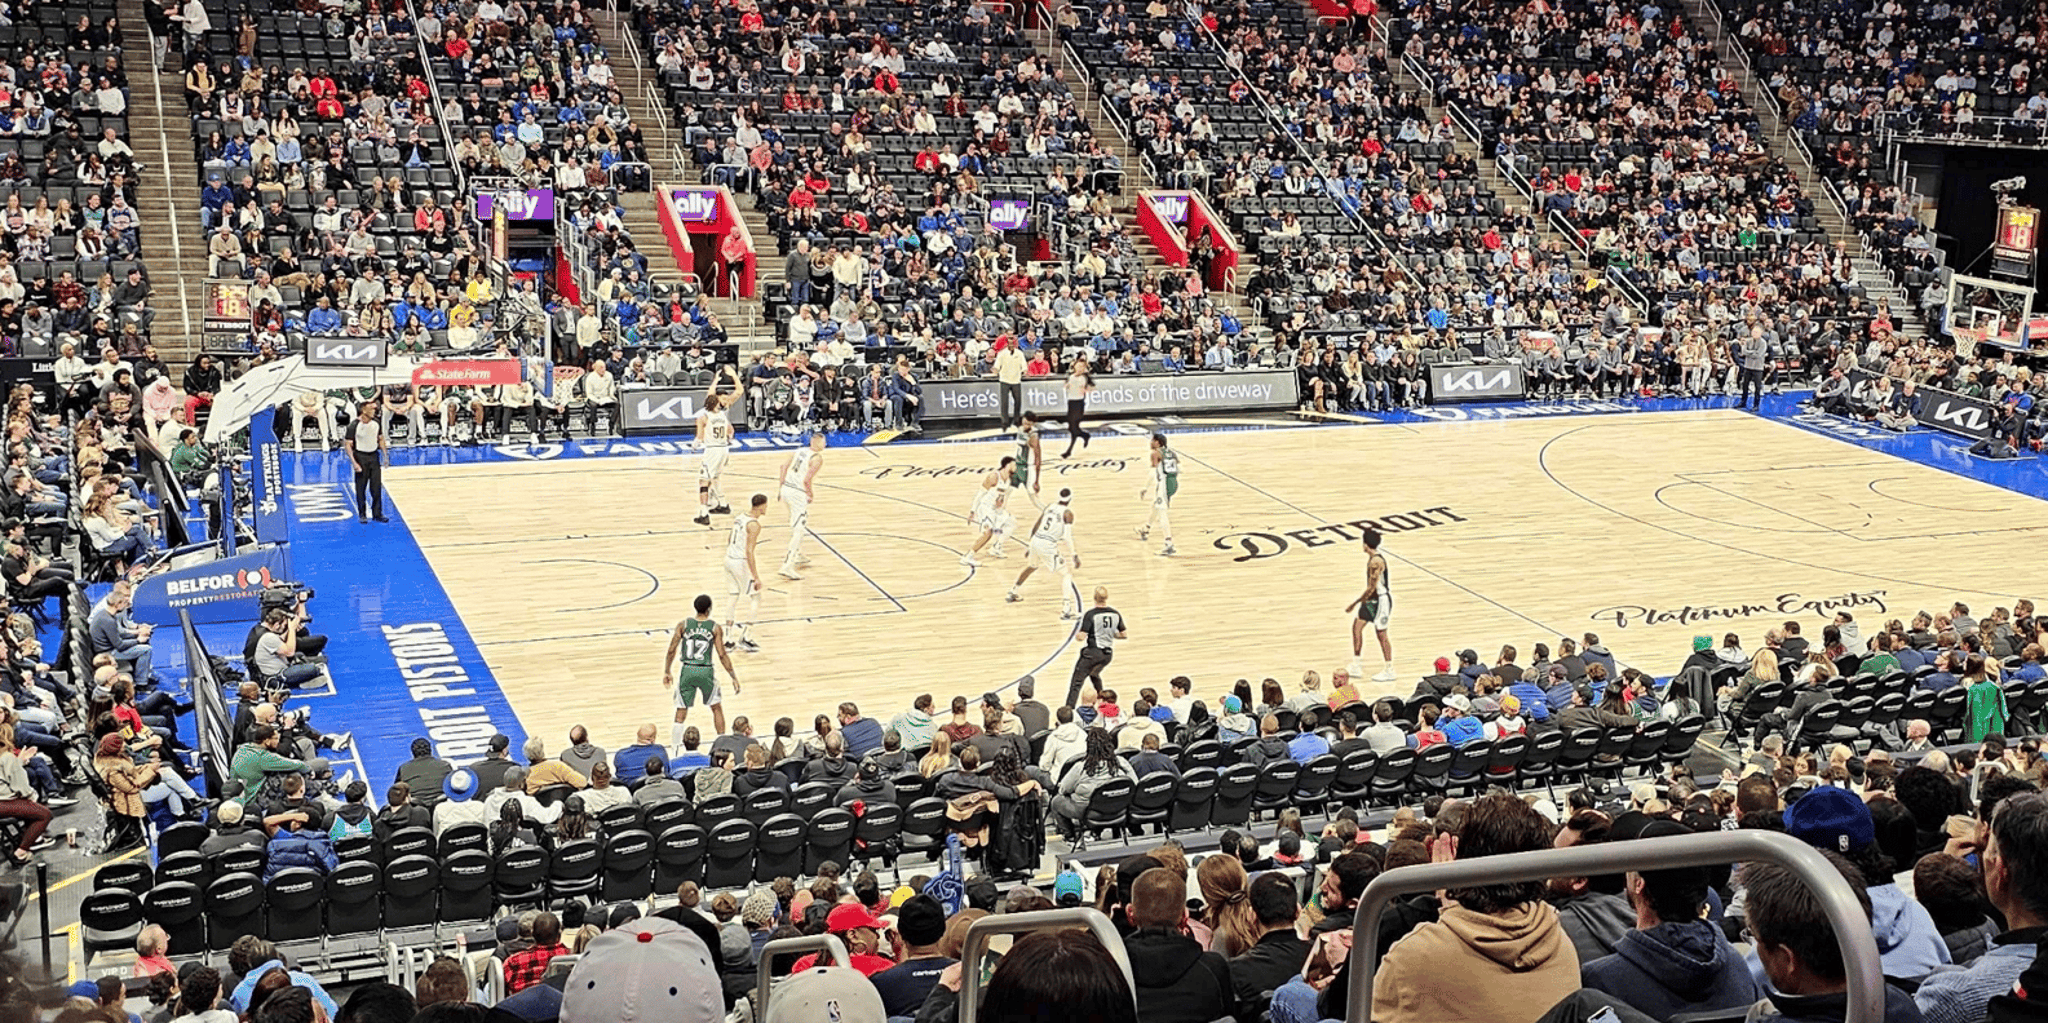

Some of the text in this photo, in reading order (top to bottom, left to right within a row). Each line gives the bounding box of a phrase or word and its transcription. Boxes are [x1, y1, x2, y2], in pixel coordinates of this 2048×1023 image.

[674, 192, 716, 218] ally
[990, 202, 1027, 228] ally
[1155, 197, 1188, 221] ally
[941, 389, 999, 408] Here's
[1027, 387, 1058, 406] the
[1138, 383, 1158, 403] of
[1161, 381, 1190, 401] the
[1195, 381, 1273, 404] driveway
[713, 426, 726, 439] 50
[260, 443, 278, 517] DRAFTKINGS
[270, 442, 283, 495] SPORTSBOOK
[285, 482, 354, 523] UWM
[1044, 517, 1054, 531] 5
[1213, 506, 1468, 563] DETROIT
[167, 574, 235, 596] BELFOR
[1103, 616, 1113, 629] 51
[1591, 590, 1887, 629] Platinum Equity
[381, 622, 477, 702] PISTONS
[686, 639, 709, 660] 17
[101, 966, 128, 977] VIP D
